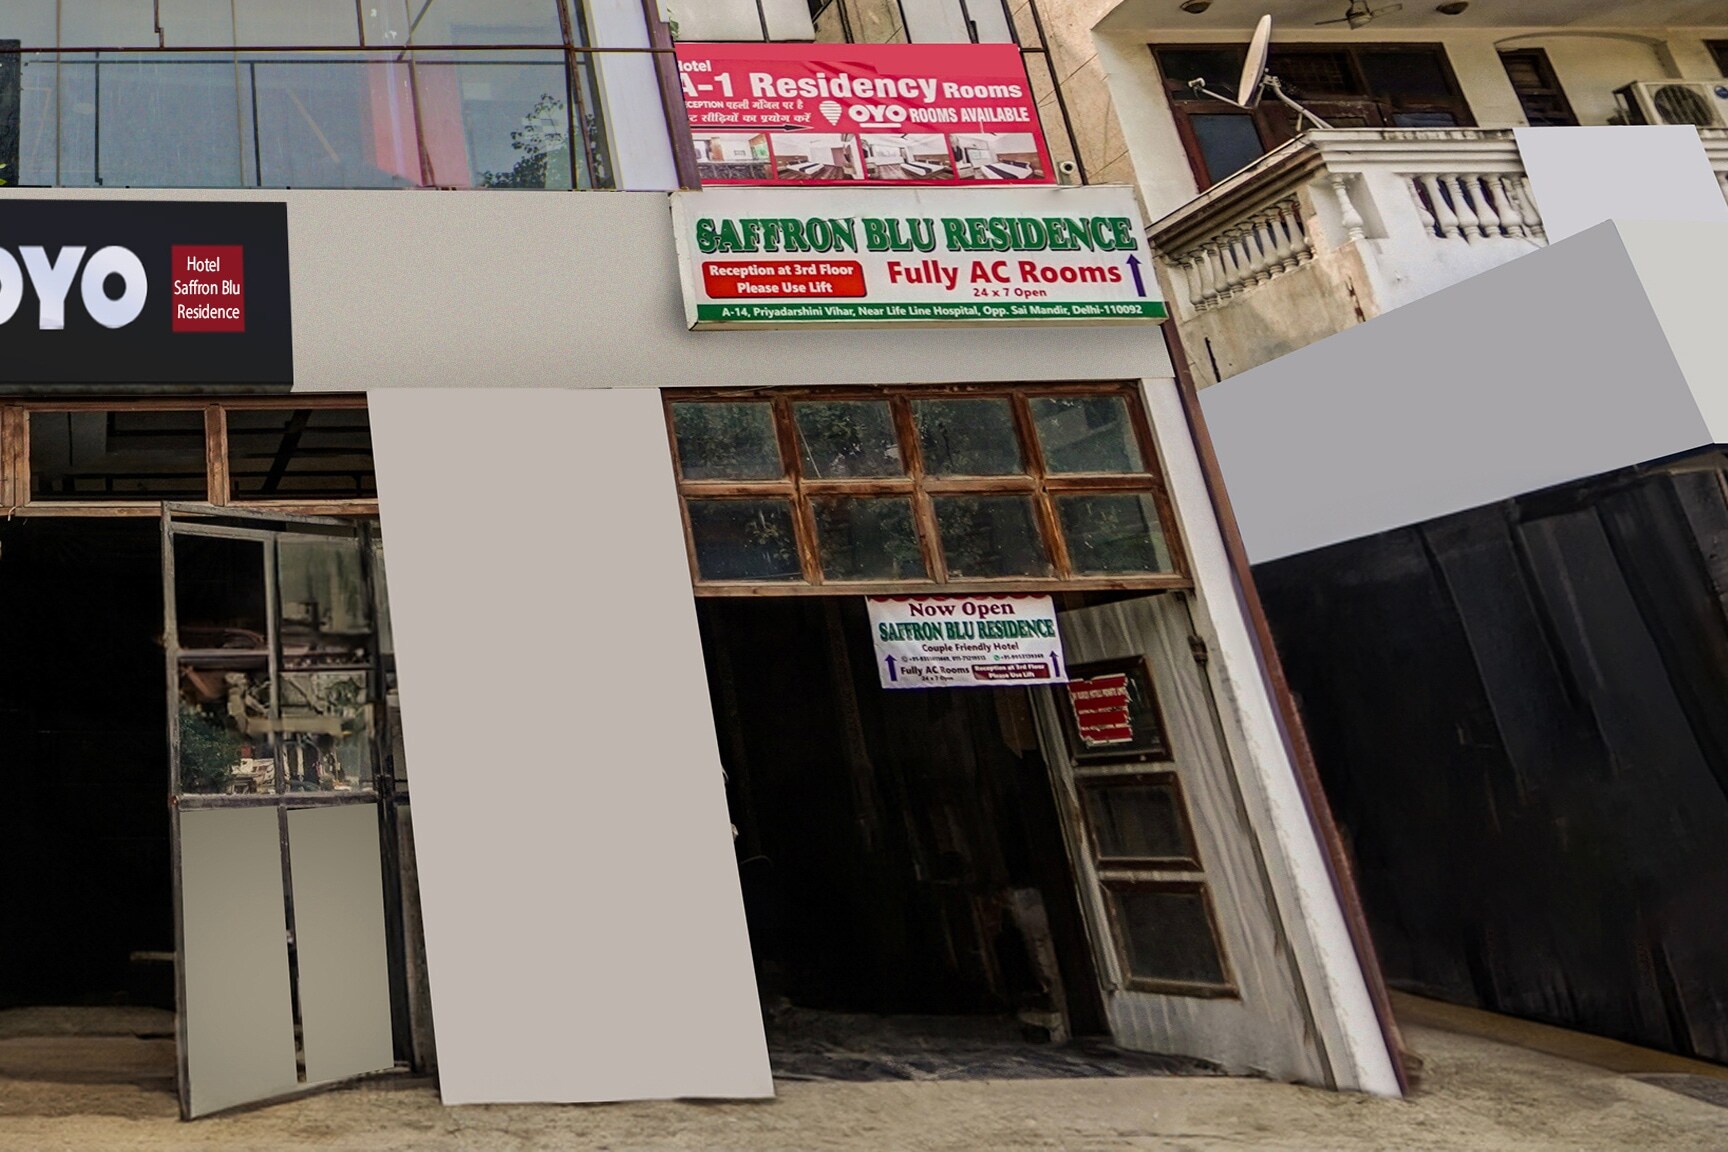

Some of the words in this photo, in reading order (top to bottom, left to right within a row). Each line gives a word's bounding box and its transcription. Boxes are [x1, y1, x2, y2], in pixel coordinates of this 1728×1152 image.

[680, 73, 734, 97] A-1
[749, 72, 937, 103] Residency
[942, 82, 1022, 98] Rooms
[685, 100, 724, 109] CEPTION
[782, 101, 794, 110] पर
[796, 99, 804, 110] है
[742, 114, 757, 122] का
[848, 104, 907, 123] OYO
[909, 107, 958, 123] ROOMS
[961, 106, 1030, 123] AVAILABLE
[696, 217, 859, 253] SAFFRON
[862, 216, 936, 252] BLU
[941, 216, 1138, 252] RESIDENCE
[187, 256, 220, 272] Hotel
[709, 264, 774, 279] Reception
[778, 265, 791, 276] at
[794, 264, 816, 276] 3rd
[820, 264, 854, 276] Floor
[887, 260, 958, 291] Fully
[970, 260, 1011, 284] AC
[1018, 260, 1122, 284] Rooms
[174, 279, 218, 295] Saffron
[222, 279, 240, 295] Blu
[737, 282, 779, 294] Please
[782, 282, 807, 294] Use
[809, 281, 833, 293] Lift
[973, 287, 989, 297] 24
[1002, 287, 1010, 297] 7
[1014, 287, 1047, 299] Open
[177, 303, 240, 319] Residence
[722, 307, 751, 318] A-14,
[753, 307, 822, 319] Priyadarshini
[825, 307, 856, 318] Vihar,
[858, 307, 884, 316] Near
[886, 306, 907, 316] Life
[909, 306, 931, 316] Line
[933, 305, 981, 317] Hospital,
[983, 305, 1009, 317] Opp.
[1011, 305, 1028, 315] Sai
[1029, 305, 1070, 316] Mandir,
[1072, 304, 1143, 315] Delhi-110092
[908, 603, 955, 617] Now
[962, 601, 1015, 619] Open
[878, 621, 944, 642] SAFFRON
[944, 621, 974, 641] BLU
[977, 619, 1055, 640] RESIDENCE
[922, 643, 953, 653] Couple
[955, 642, 991, 653] Friendly
[993, 642, 1019, 651] Hotel
[901, 665, 922, 675] Fully
[926, 666, 939, 674] AC
[941, 666, 970, 674] Rooms
